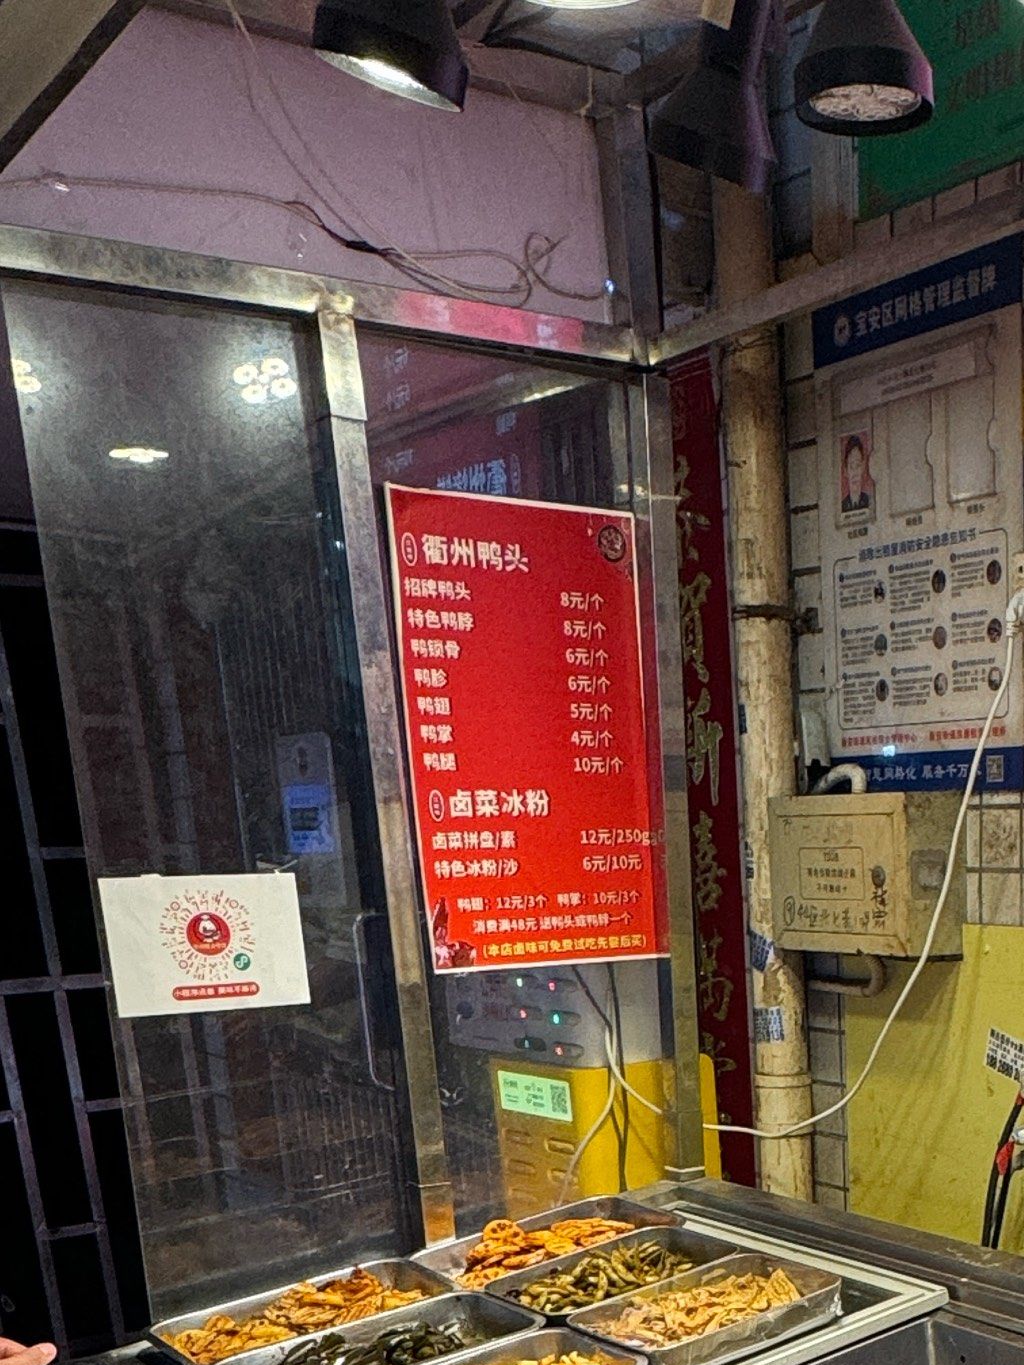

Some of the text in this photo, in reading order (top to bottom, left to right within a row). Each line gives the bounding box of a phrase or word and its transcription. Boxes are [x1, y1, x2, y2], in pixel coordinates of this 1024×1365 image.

[421, 533, 529, 574] 衢州鸭头
[404, 577, 472, 601] 招牌鸭头
[560, 592, 605, 613] 8元/个
[407, 608, 475, 633] 特色鸭脖
[563, 620, 607, 641] 8元/个
[410, 638, 461, 660] 鸭锁骨
[565, 649, 609, 668] 6元/个
[568, 676, 611, 695] 6元/个
[570, 703, 613, 722] 5元/个
[420, 724, 453, 745] 鸭掌
[570, 730, 614, 749] 4元/个
[423, 752, 458, 772] 鸭腿
[573, 757, 624, 776] 10元/个
[449, 788, 551, 818] 卤菜冰粉
[580, 828, 651, 847] 12元/250g
[433, 857, 519, 880] 特色冰粉/沙
[582, 853, 643, 873] 6元/10元
